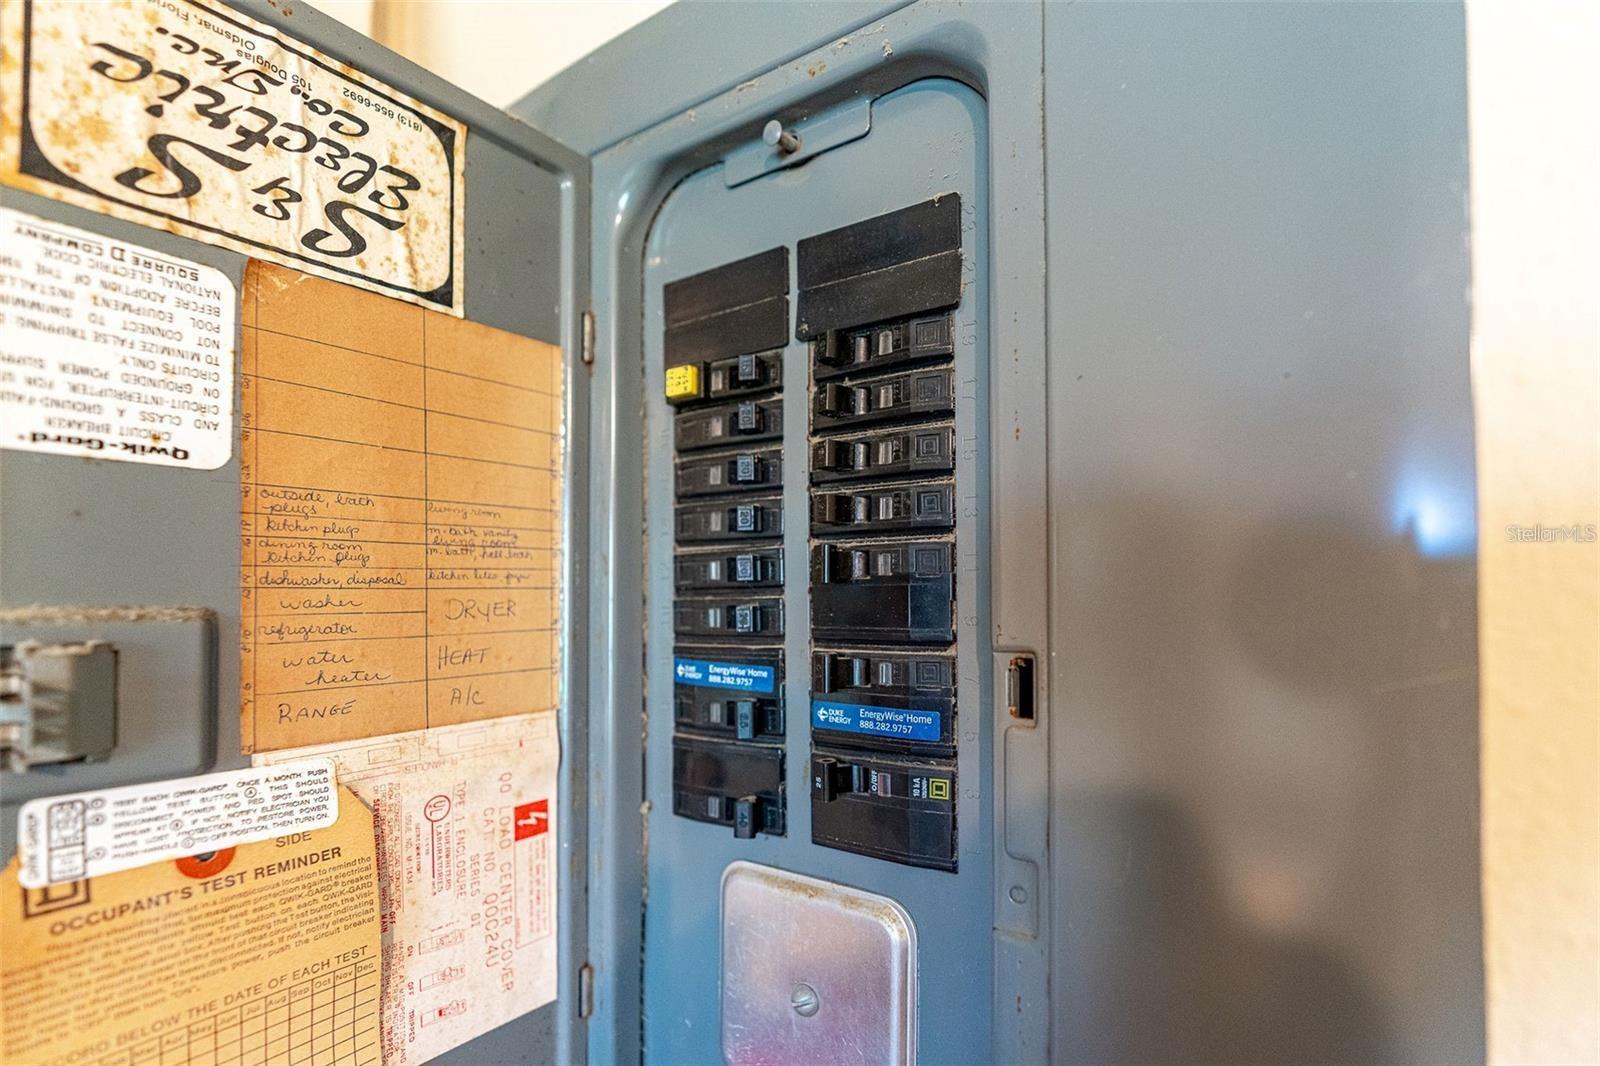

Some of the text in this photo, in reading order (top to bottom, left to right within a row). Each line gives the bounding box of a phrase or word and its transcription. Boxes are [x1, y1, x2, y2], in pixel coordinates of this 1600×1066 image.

[155, 27, 283, 95] Inc.
[235, 47, 313, 92] 105 Douglas
[342, 87, 423, 133] (813) 855-6692
[89, 42, 421, 211] Electric
[114, 133, 251, 200] S
[301, 200, 405, 258] S
[14, 226, 199, 282] SQUARE D COMPANY
[73, 273, 91, 286] OF
[85, 258, 221, 301] NATIONAL ELECTRIC
[99, 280, 166, 305] ADOPTION
[175, 297, 221, 317] BEFORE
[88, 313, 221, 350] NOT CONNECT TO
[189, 317, 221, 333] POOL
[91, 331, 135, 349] FALSE
[139, 341, 201, 363] MINIMIZE
[205, 354, 220, 366] TO
[58, 362, 220, 399] ON GROUNDED POWER
[162, 363, 220, 382] CIRCUITS
[45, 416, 111, 434] BREAKER
[116, 407, 220, 431] AND CLASS A
[742, 408, 751, 423] 20
[741, 460, 751, 474] 20
[259, 489, 329, 508] outside,
[262, 504, 317, 520] plugs
[740, 511, 750, 525] 20
[266, 516, 360, 538] kitchen plugs
[259, 539, 363, 554] dining room
[262, 551, 370, 566] kitchen plugs
[259, 570, 406, 589] dishwasher, disposal
[280, 599, 365, 610] washer
[445, 598, 517, 623] DRYER
[258, 624, 358, 641] refrigerator
[282, 650, 355, 668] water
[437, 645, 491, 670] HEAT
[306, 670, 393, 686] heater
[708, 674, 753, 686] 888.282.9757
[747, 669, 768, 678] Home
[449, 682, 486, 706] A/C
[278, 699, 357, 725] RANGE
[905, 713, 932, 724] Home
[828, 716, 913, 734] ENERGY 888.282.9757
[269, 777, 329, 792] THIS SHOULD
[273, 768, 328, 784] MONTH PUSH
[815, 776, 822, 788] 25
[271, 786, 330, 802] SPOT SHOULD
[913, 777, 920, 797] 10 kA
[261, 795, 329, 814] ELECTRICIAN YOU
[272, 816, 315, 829] THEN TURN
[498, 806, 511, 850] LOAD
[275, 831, 312, 848] SIDE
[454, 781, 467, 899] TYPE ENCLOSURE
[282, 856, 371, 886] location to remind the
[470, 853, 480, 897] SERIES
[49, 846, 342, 937] OCCUPANT'S TEST REMINDER
[252, 872, 373, 913] each breaker
[253, 864, 372, 902] protection against electrical
[499, 862, 512, 925] CENTER
[245, 912, 276, 925] button
[297, 898, 319, 910] each
[322, 881, 373, 902] QWIK-GARD
[234, 896, 355, 937] pushing the Test the
[265, 899, 374, 937] circuit breaker indicating
[306, 907, 375, 934] notify electrician
[380, 913, 389, 934] MAIN
[388, 911, 396, 925] OFF
[268, 943, 291, 958] push
[294, 938, 310, 948] the
[314, 926, 340, 941] circuit
[344, 916, 376, 930] breaker
[407, 945, 414, 957] ON
[500, 938, 513, 993] COVER
[268, 995, 287, 1007] Aug
[291, 987, 310, 998] Sep
[315, 978, 331, 989] Oct
[336, 970, 353, 981] Nov
[357, 962, 374, 973] Dec
[114, 945, 368, 1046] BELOW THE DATE OF EACH TEST
